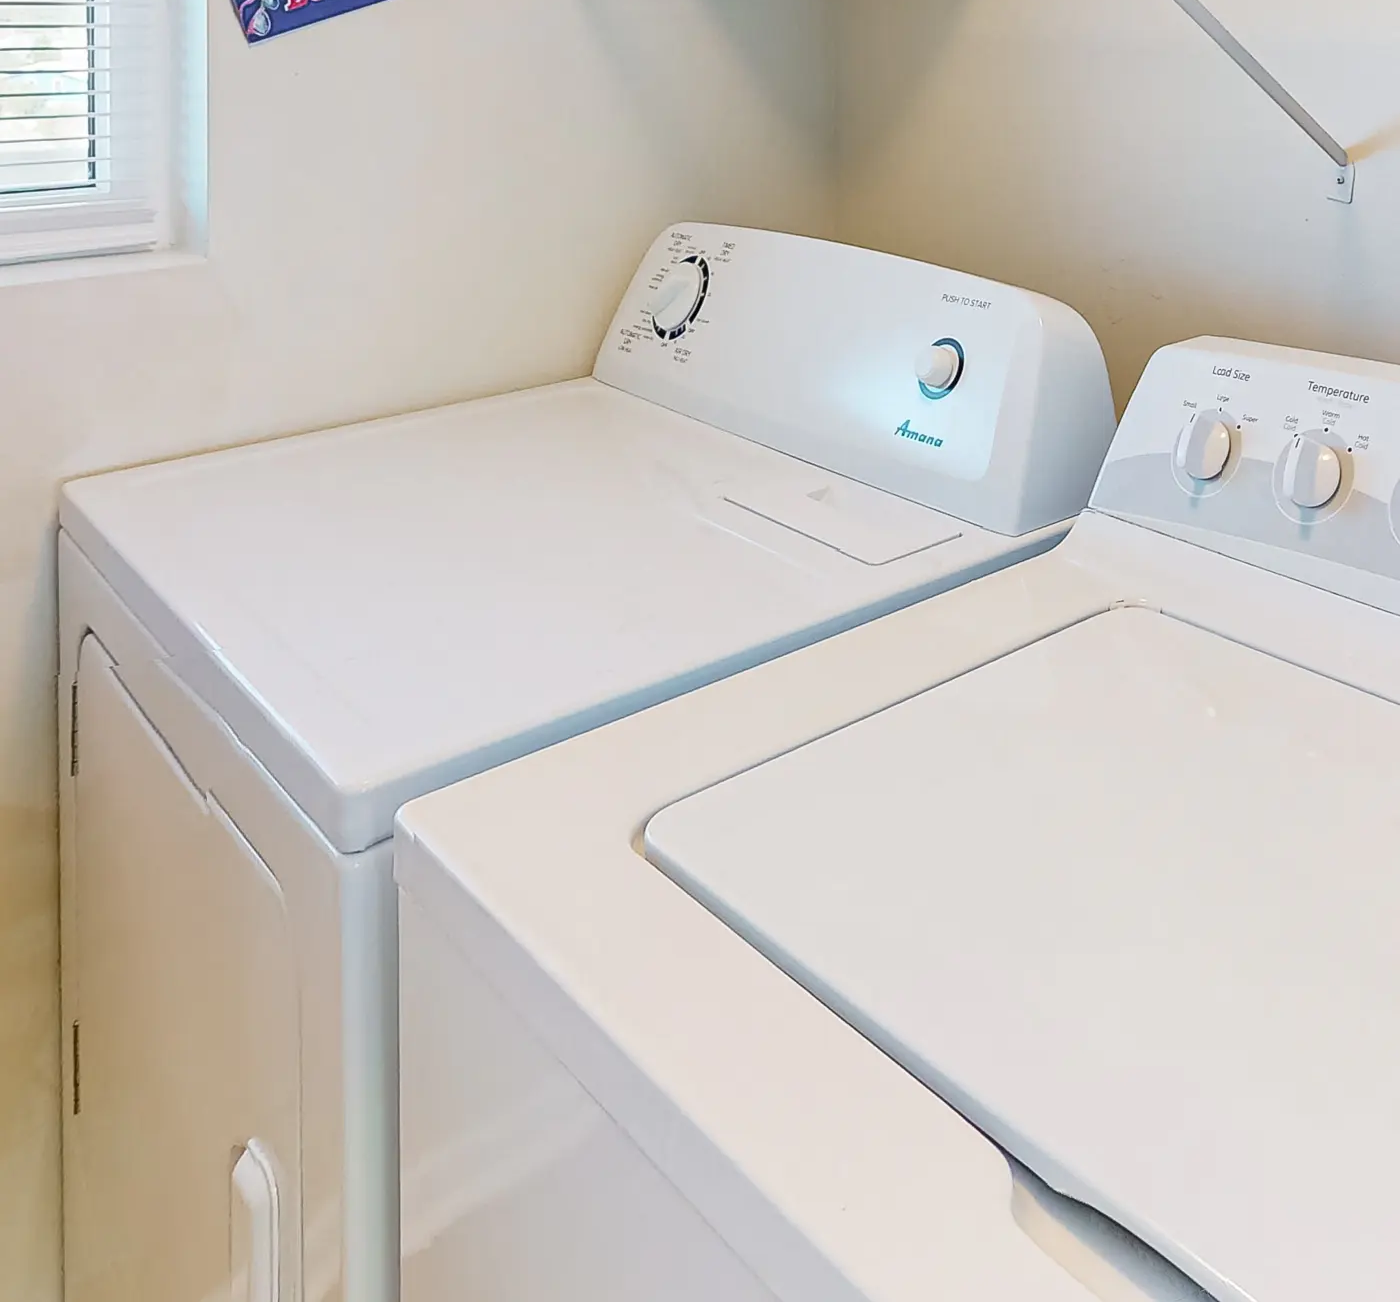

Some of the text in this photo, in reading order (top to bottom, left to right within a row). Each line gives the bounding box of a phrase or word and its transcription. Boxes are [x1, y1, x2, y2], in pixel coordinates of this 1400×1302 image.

[941, 293, 992, 309] PUSH TO START
[1212, 365, 1251, 382] Load Size
[1307, 380, 1370, 404] Temperature
[1242, 413, 1259, 423] Super
[1285, 415, 1299, 424] Cold
[1322, 409, 1341, 419] Warm
[894, 419, 944, 448] Amana
